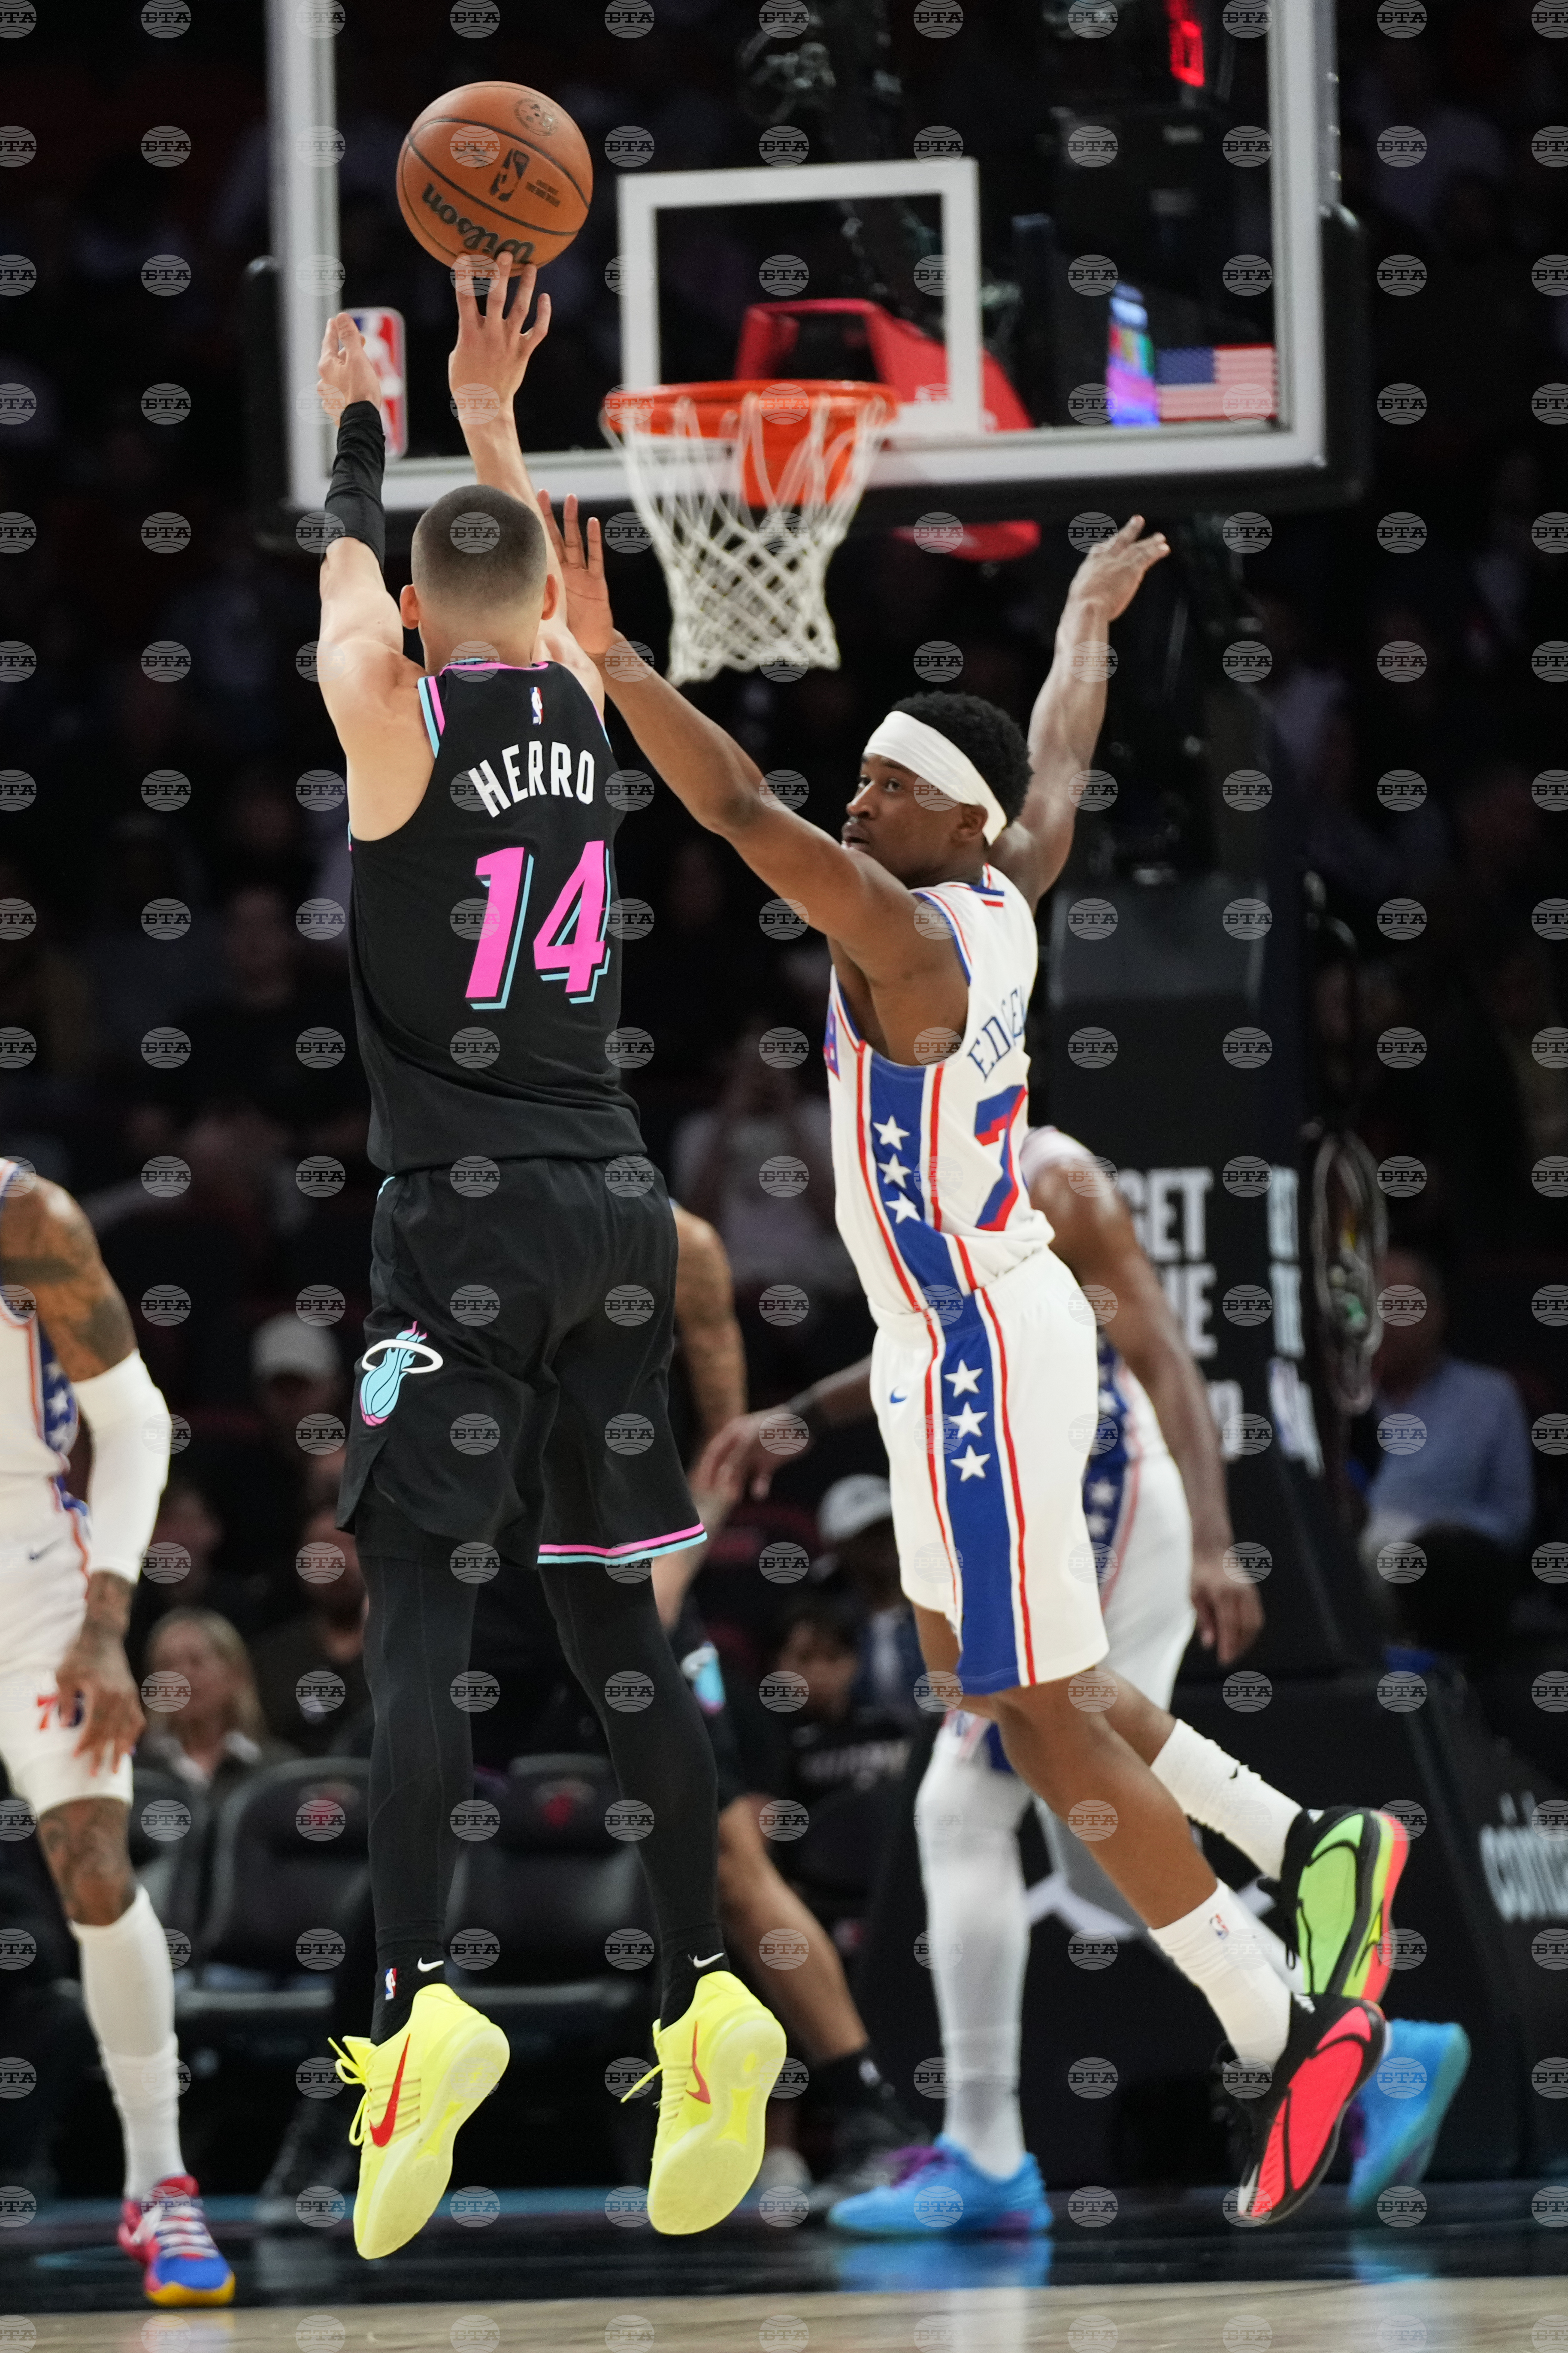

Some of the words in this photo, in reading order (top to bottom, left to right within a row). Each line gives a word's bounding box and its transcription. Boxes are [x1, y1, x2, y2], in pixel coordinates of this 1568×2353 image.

[422, 182, 535, 264] Wilson
[468, 740, 595, 818] HERRO
[465, 840, 611, 1010] 14
